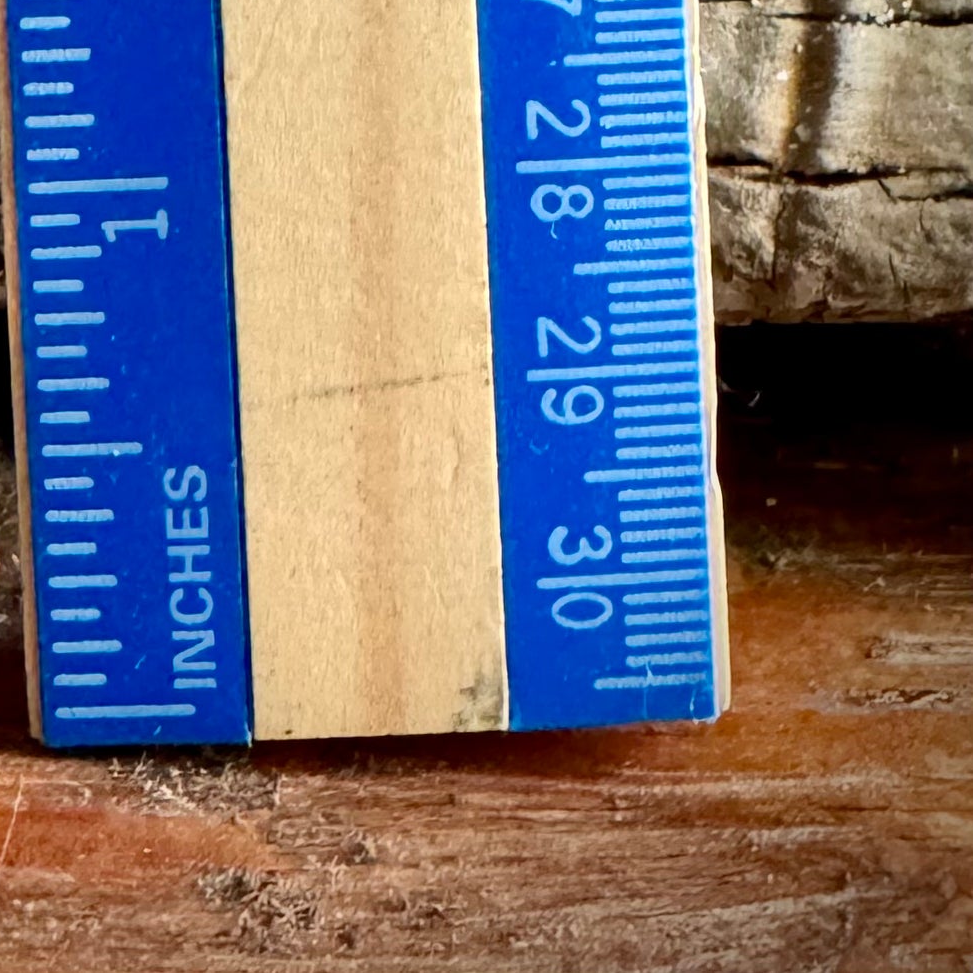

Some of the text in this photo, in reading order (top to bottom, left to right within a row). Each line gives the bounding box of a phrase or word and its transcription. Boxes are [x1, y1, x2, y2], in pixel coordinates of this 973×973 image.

[525, 98, 595, 223] 28
[100, 209, 169, 241] 1
[535, 316, 606, 426] 29
[162, 463, 219, 690] INCHES
[545, 524, 615, 631] 30
